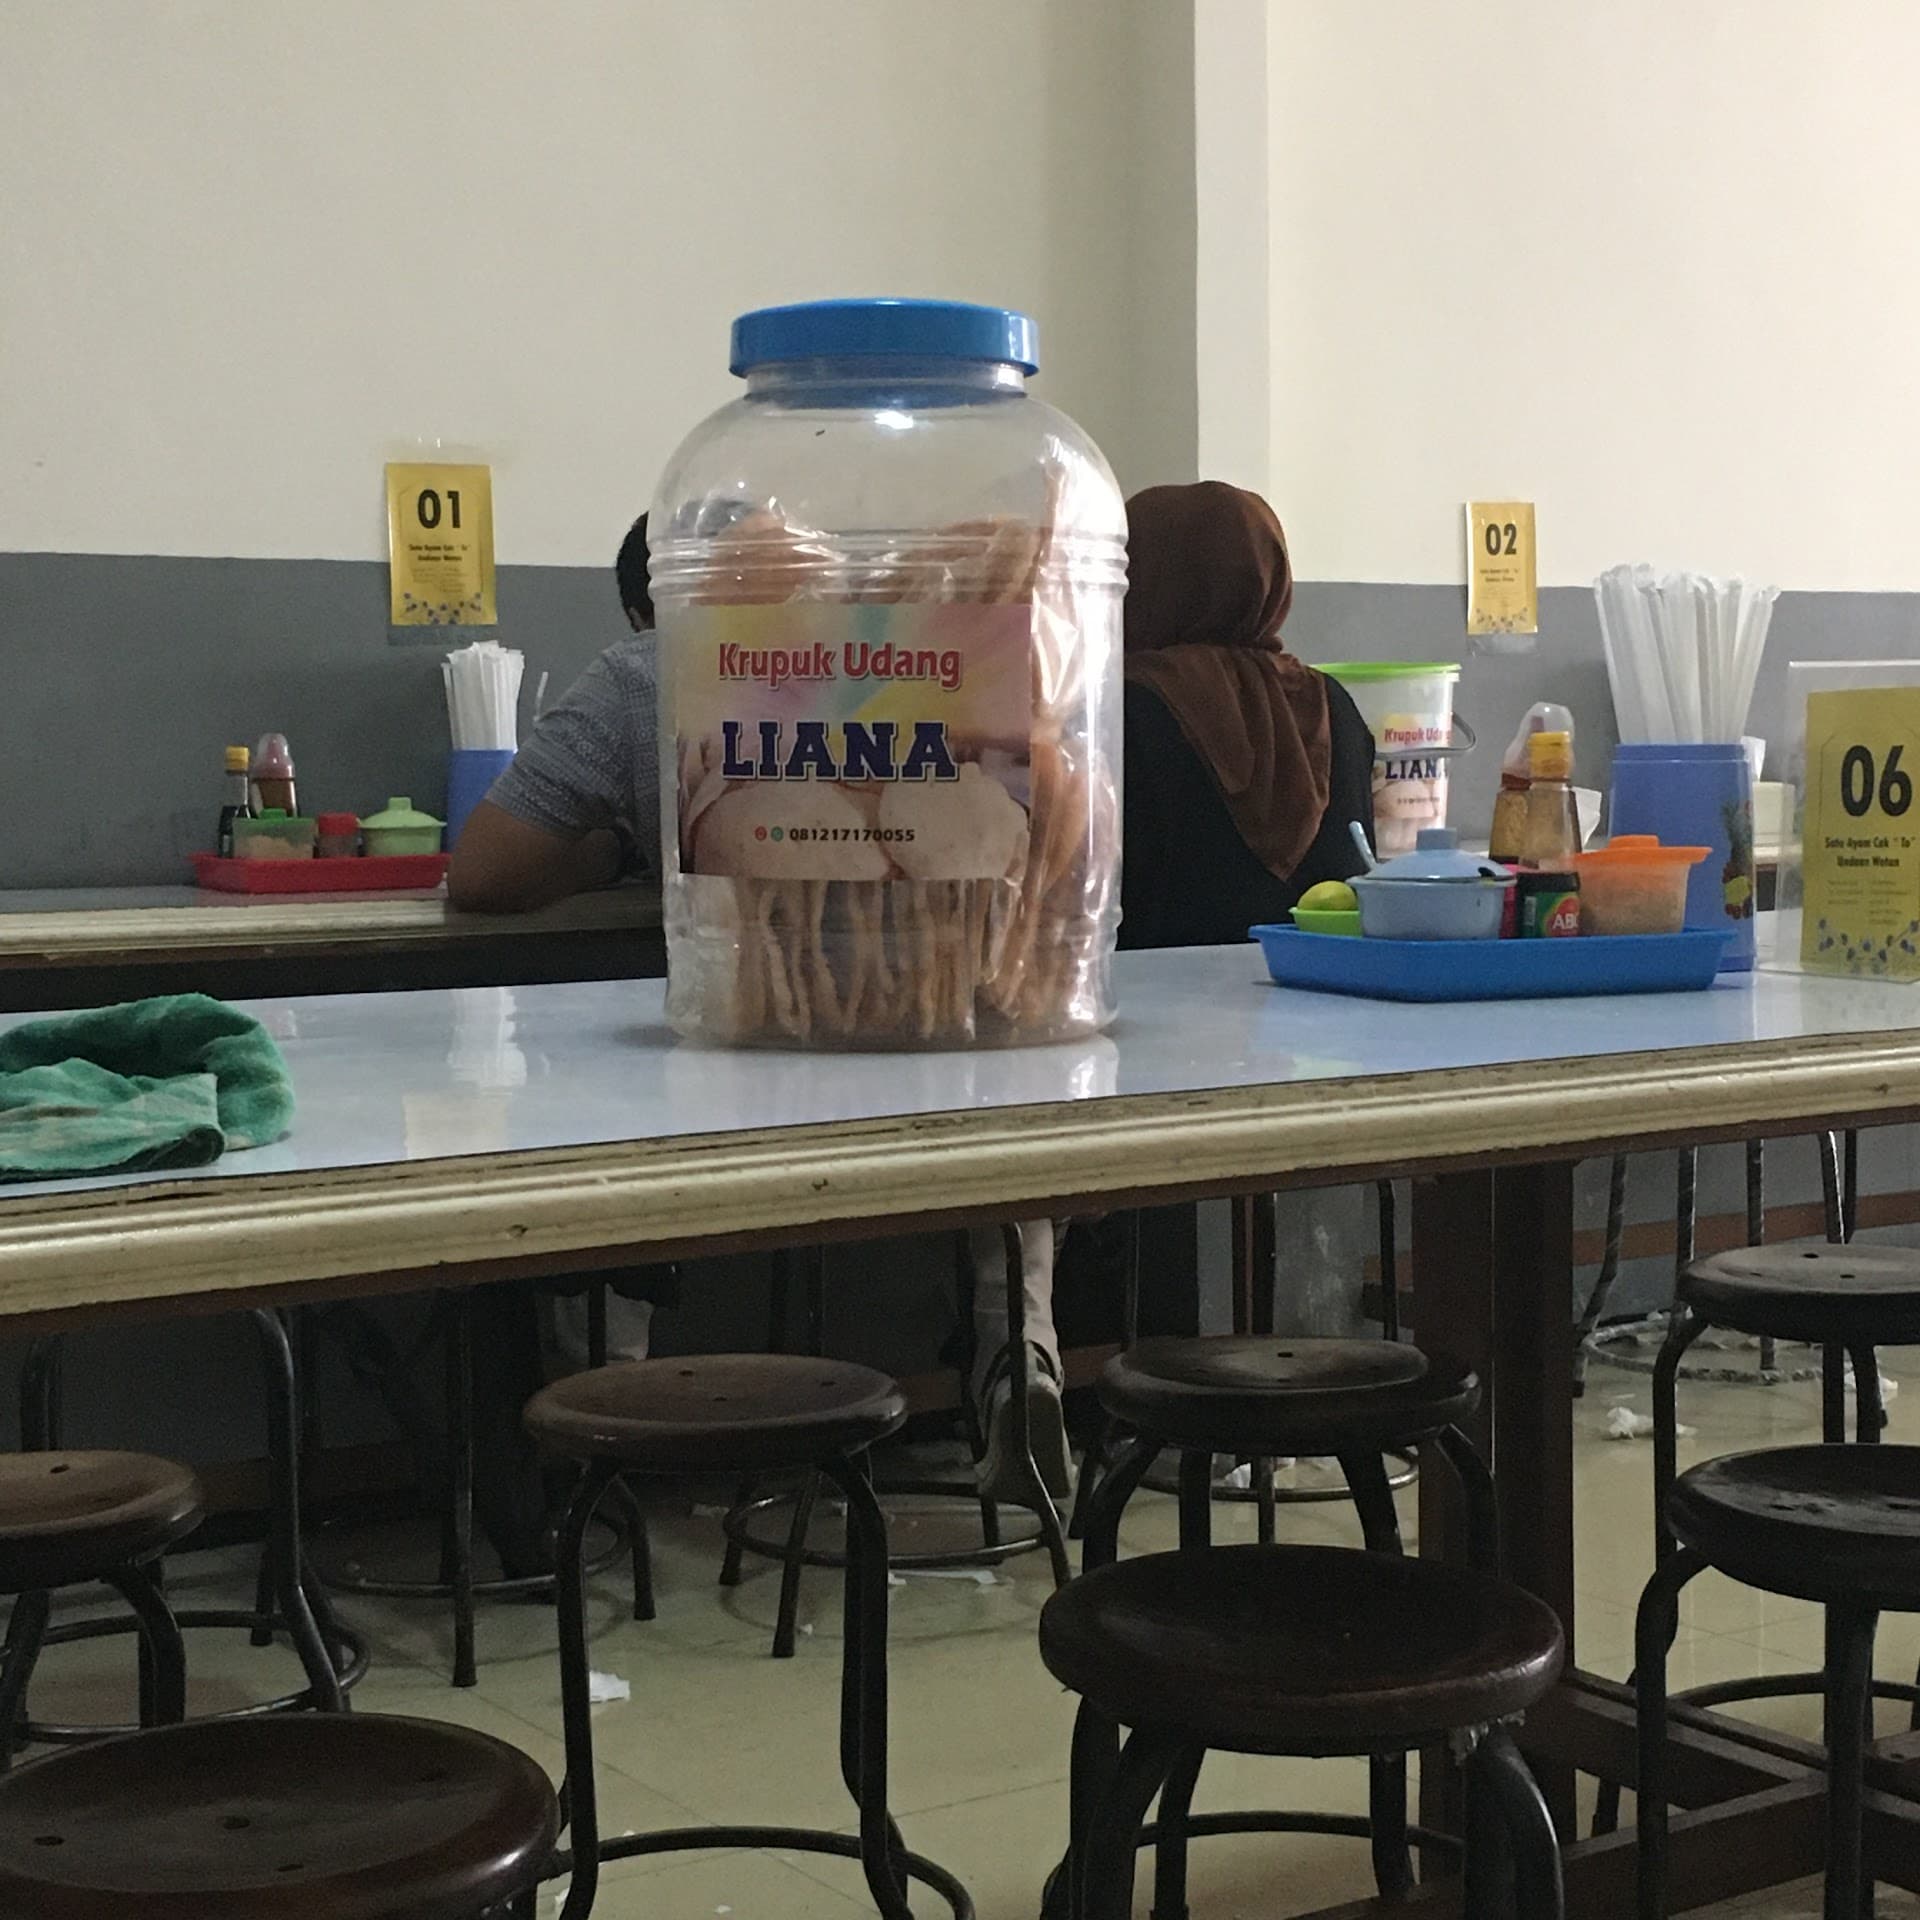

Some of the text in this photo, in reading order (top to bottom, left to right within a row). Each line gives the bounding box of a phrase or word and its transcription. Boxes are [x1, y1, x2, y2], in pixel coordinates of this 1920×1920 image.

[417, 488, 461, 529] 01
[1485, 523, 1517, 556] 02
[719, 642, 961, 691] Krupuk Udang
[722, 720, 959, 781] LIANA
[1840, 744, 1913, 817] 06
[789, 828, 915, 841] 081217170055
